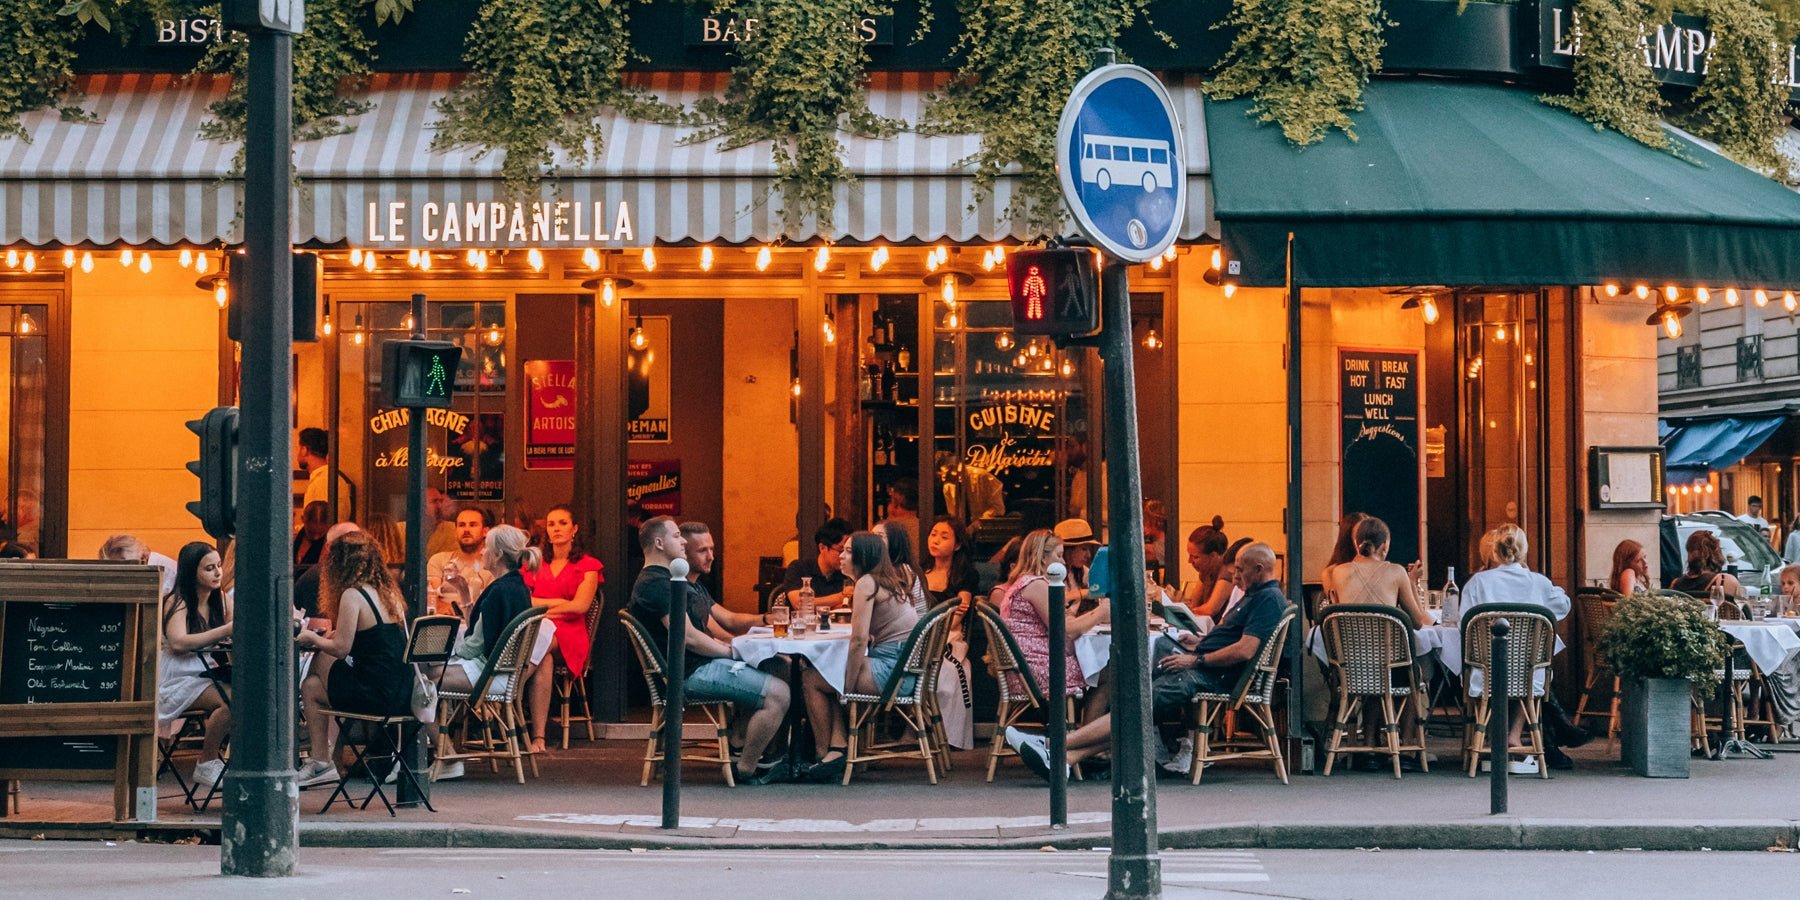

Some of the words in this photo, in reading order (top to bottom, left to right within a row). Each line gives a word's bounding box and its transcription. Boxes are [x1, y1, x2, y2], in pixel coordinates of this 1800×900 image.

[369, 202, 405, 241] LE
[422, 202, 634, 241] CAMPANELLA
[1345, 359, 1370, 371] DRINK
[1382, 361, 1408, 373] BREAK
[532, 374, 576, 390] STELLA
[1350, 375, 1366, 387] HOT
[1386, 377, 1406, 389] FAST
[1364, 393, 1393, 406] LUNCH
[1365, 408, 1389, 420] WELL
[533, 417, 575, 430] ARTOIS
[27, 639, 48, 651] Tom
[51, 640, 83, 653] Collins
[27, 679, 46, 688] Old
